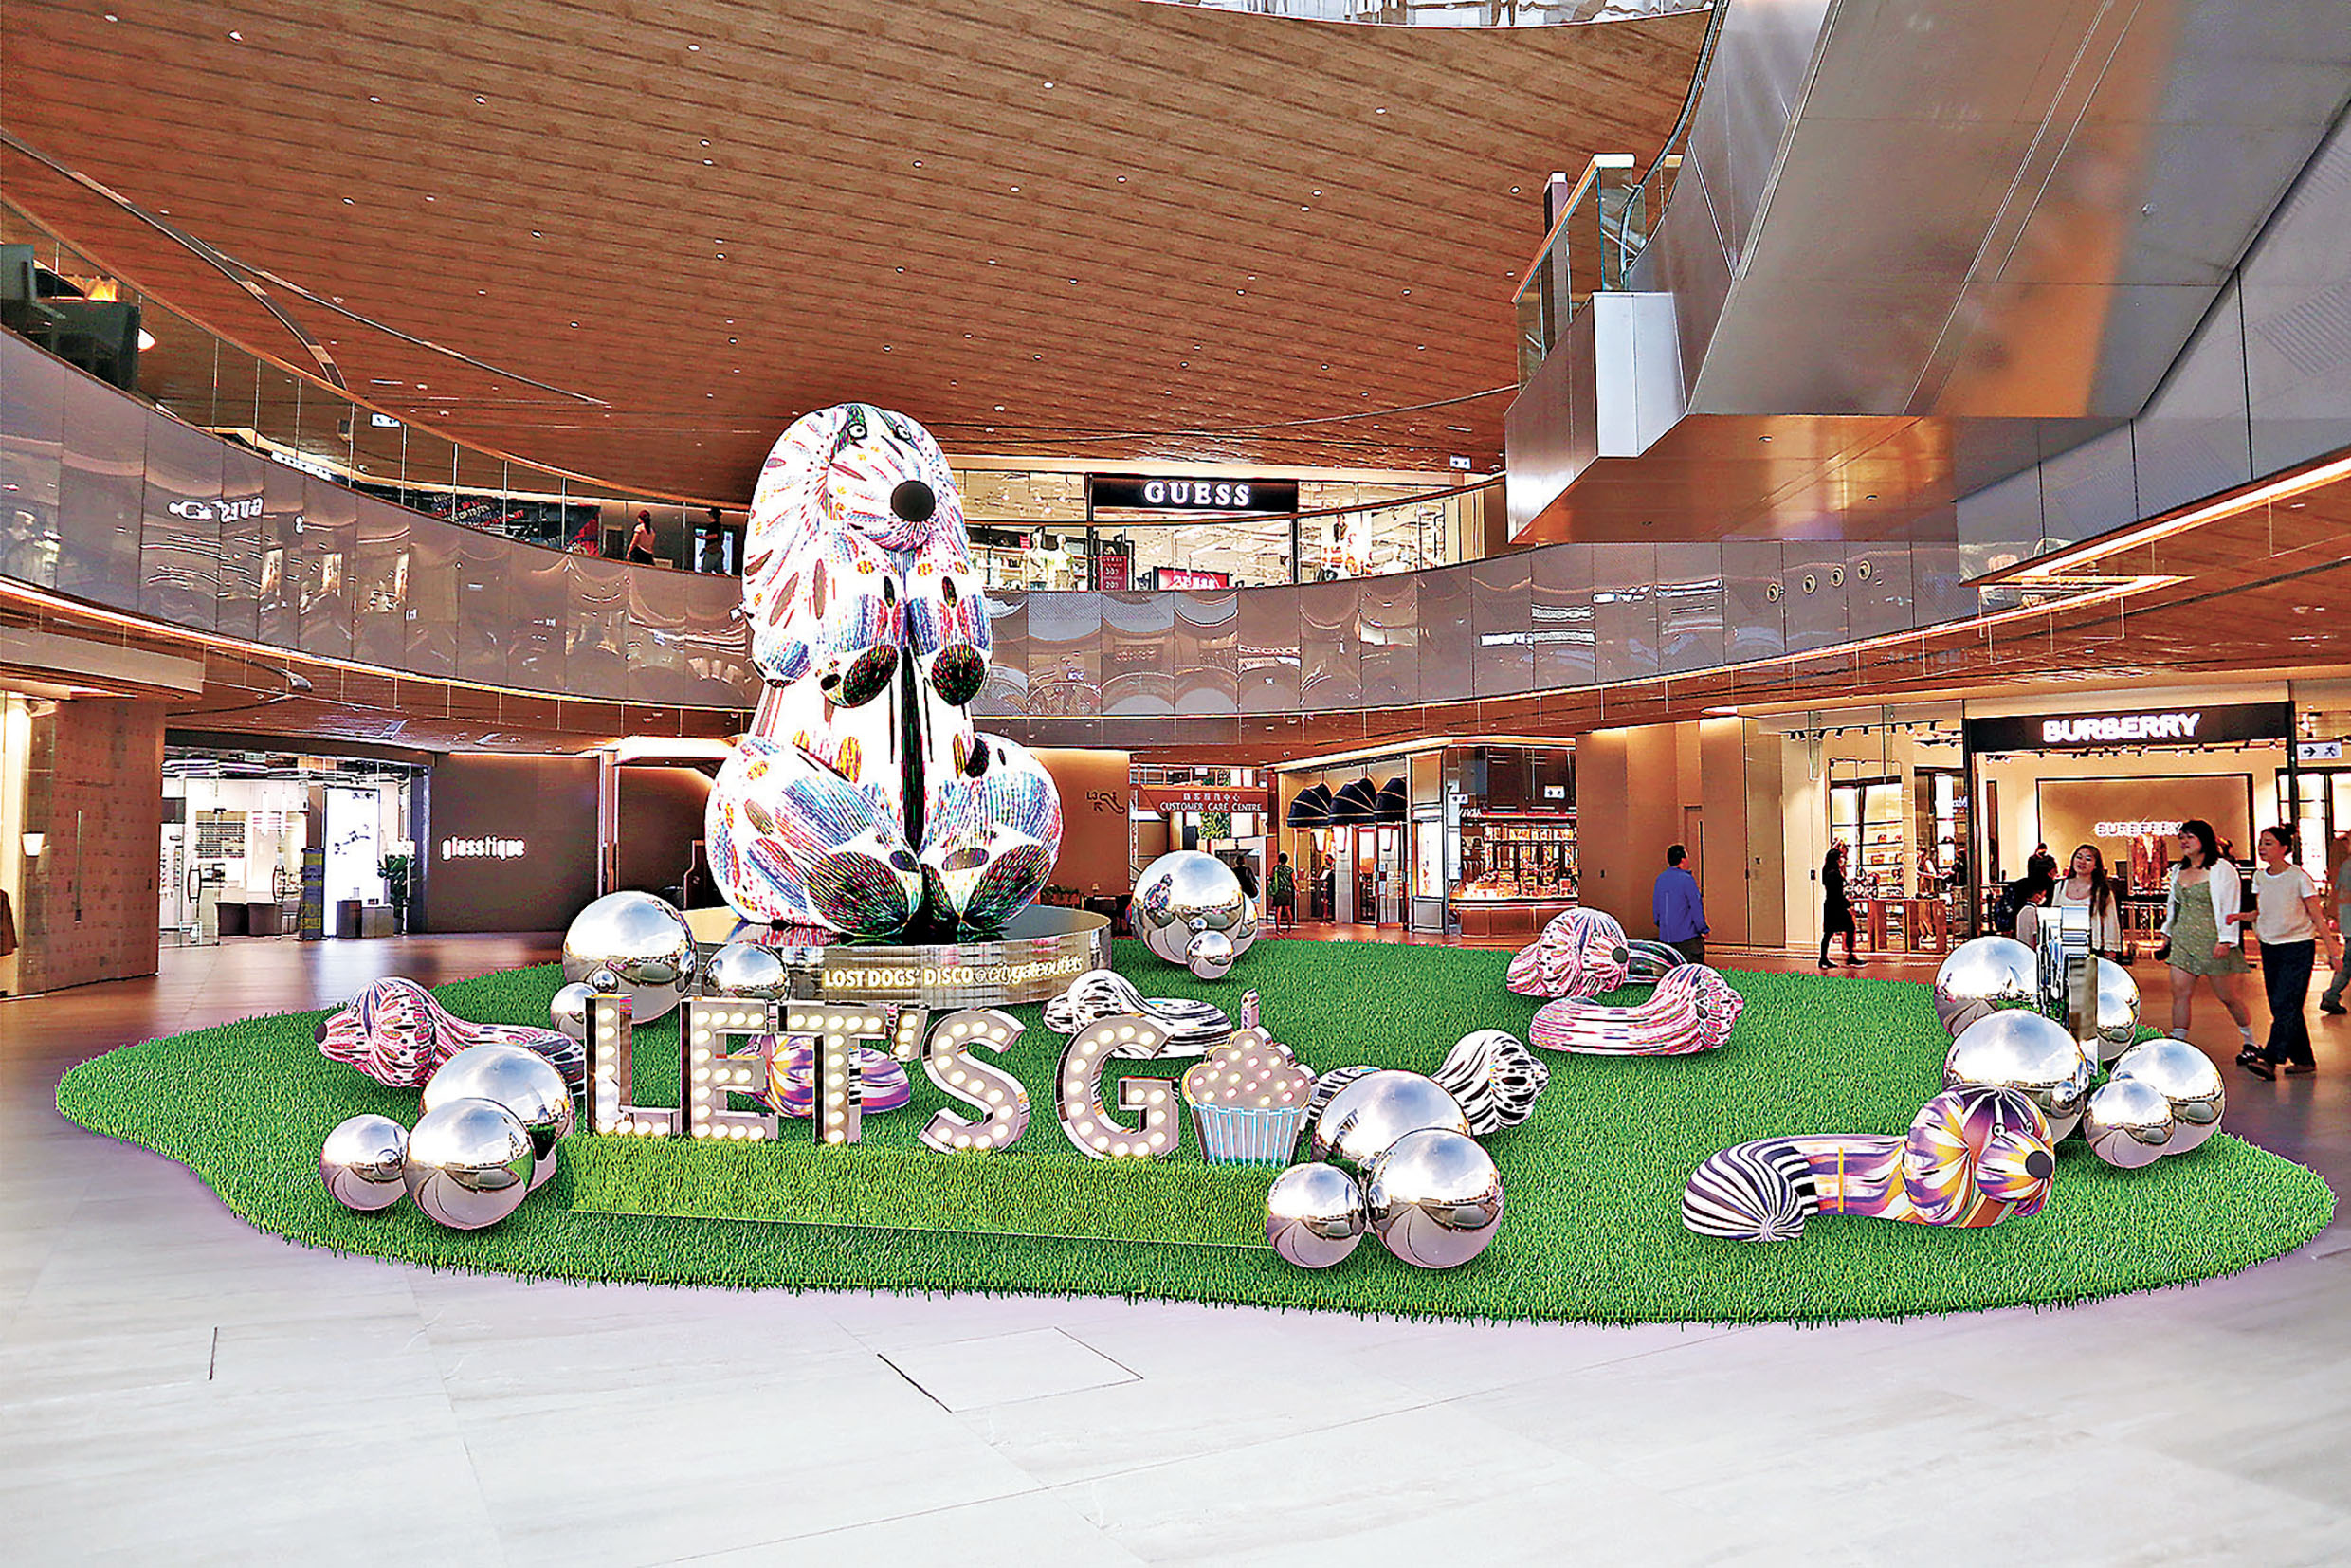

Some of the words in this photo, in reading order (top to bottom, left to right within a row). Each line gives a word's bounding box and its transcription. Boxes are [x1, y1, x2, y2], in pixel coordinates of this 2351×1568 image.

[1143, 480, 1250, 507] GUESS
[2042, 712, 2201, 743] BURBERRY
[1159, 801, 1204, 811] CUSTOMER
[1207, 802, 1229, 811] CARE
[1231, 802, 1263, 811] CENTRE
[440, 835, 527, 861] glasstique
[824, 969, 866, 988] LOST
[923, 967, 974, 986] DISCO
[585, 994, 1030, 1153] LET'S
